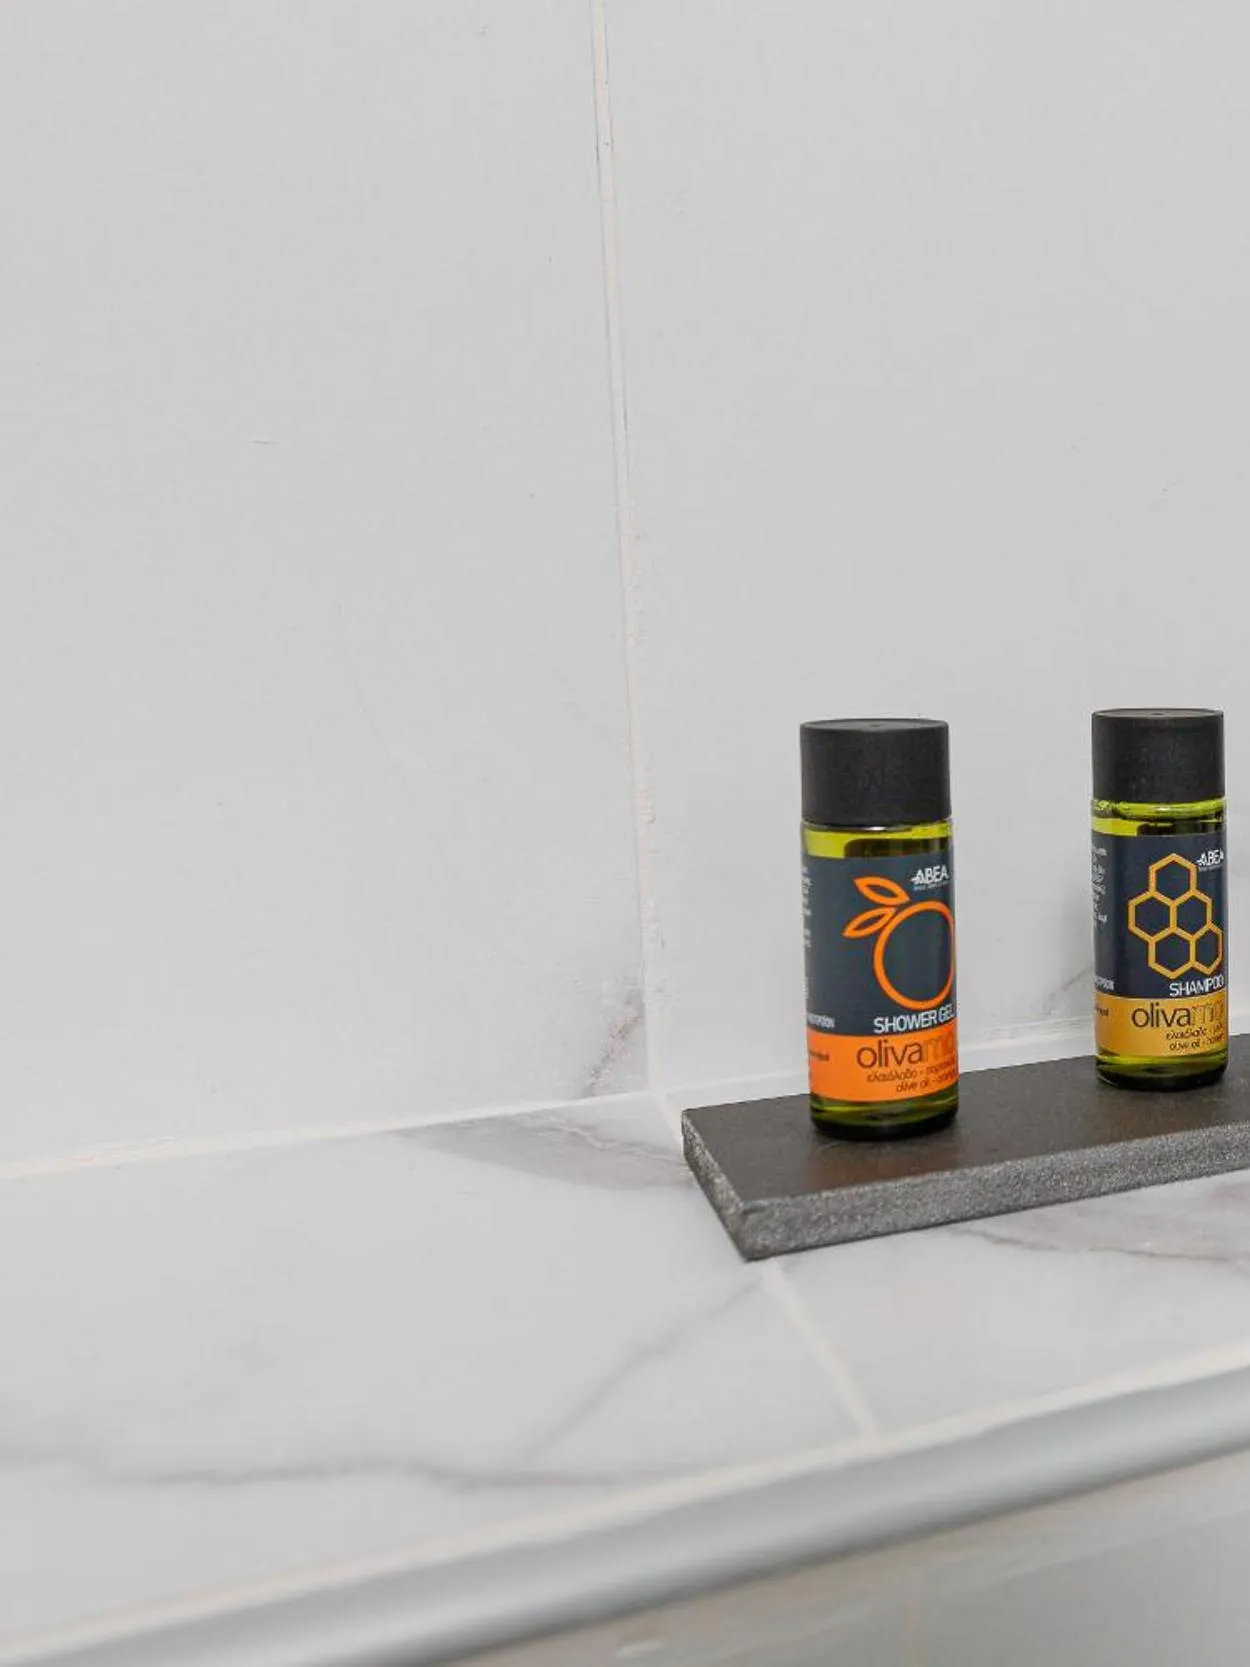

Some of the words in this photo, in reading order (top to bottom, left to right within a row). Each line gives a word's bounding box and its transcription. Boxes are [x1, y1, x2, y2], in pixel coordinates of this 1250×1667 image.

[910, 864, 949, 885] ABEA
[1169, 974, 1225, 997] SHAMPOO
[873, 1010, 937, 1034] SHOWER
